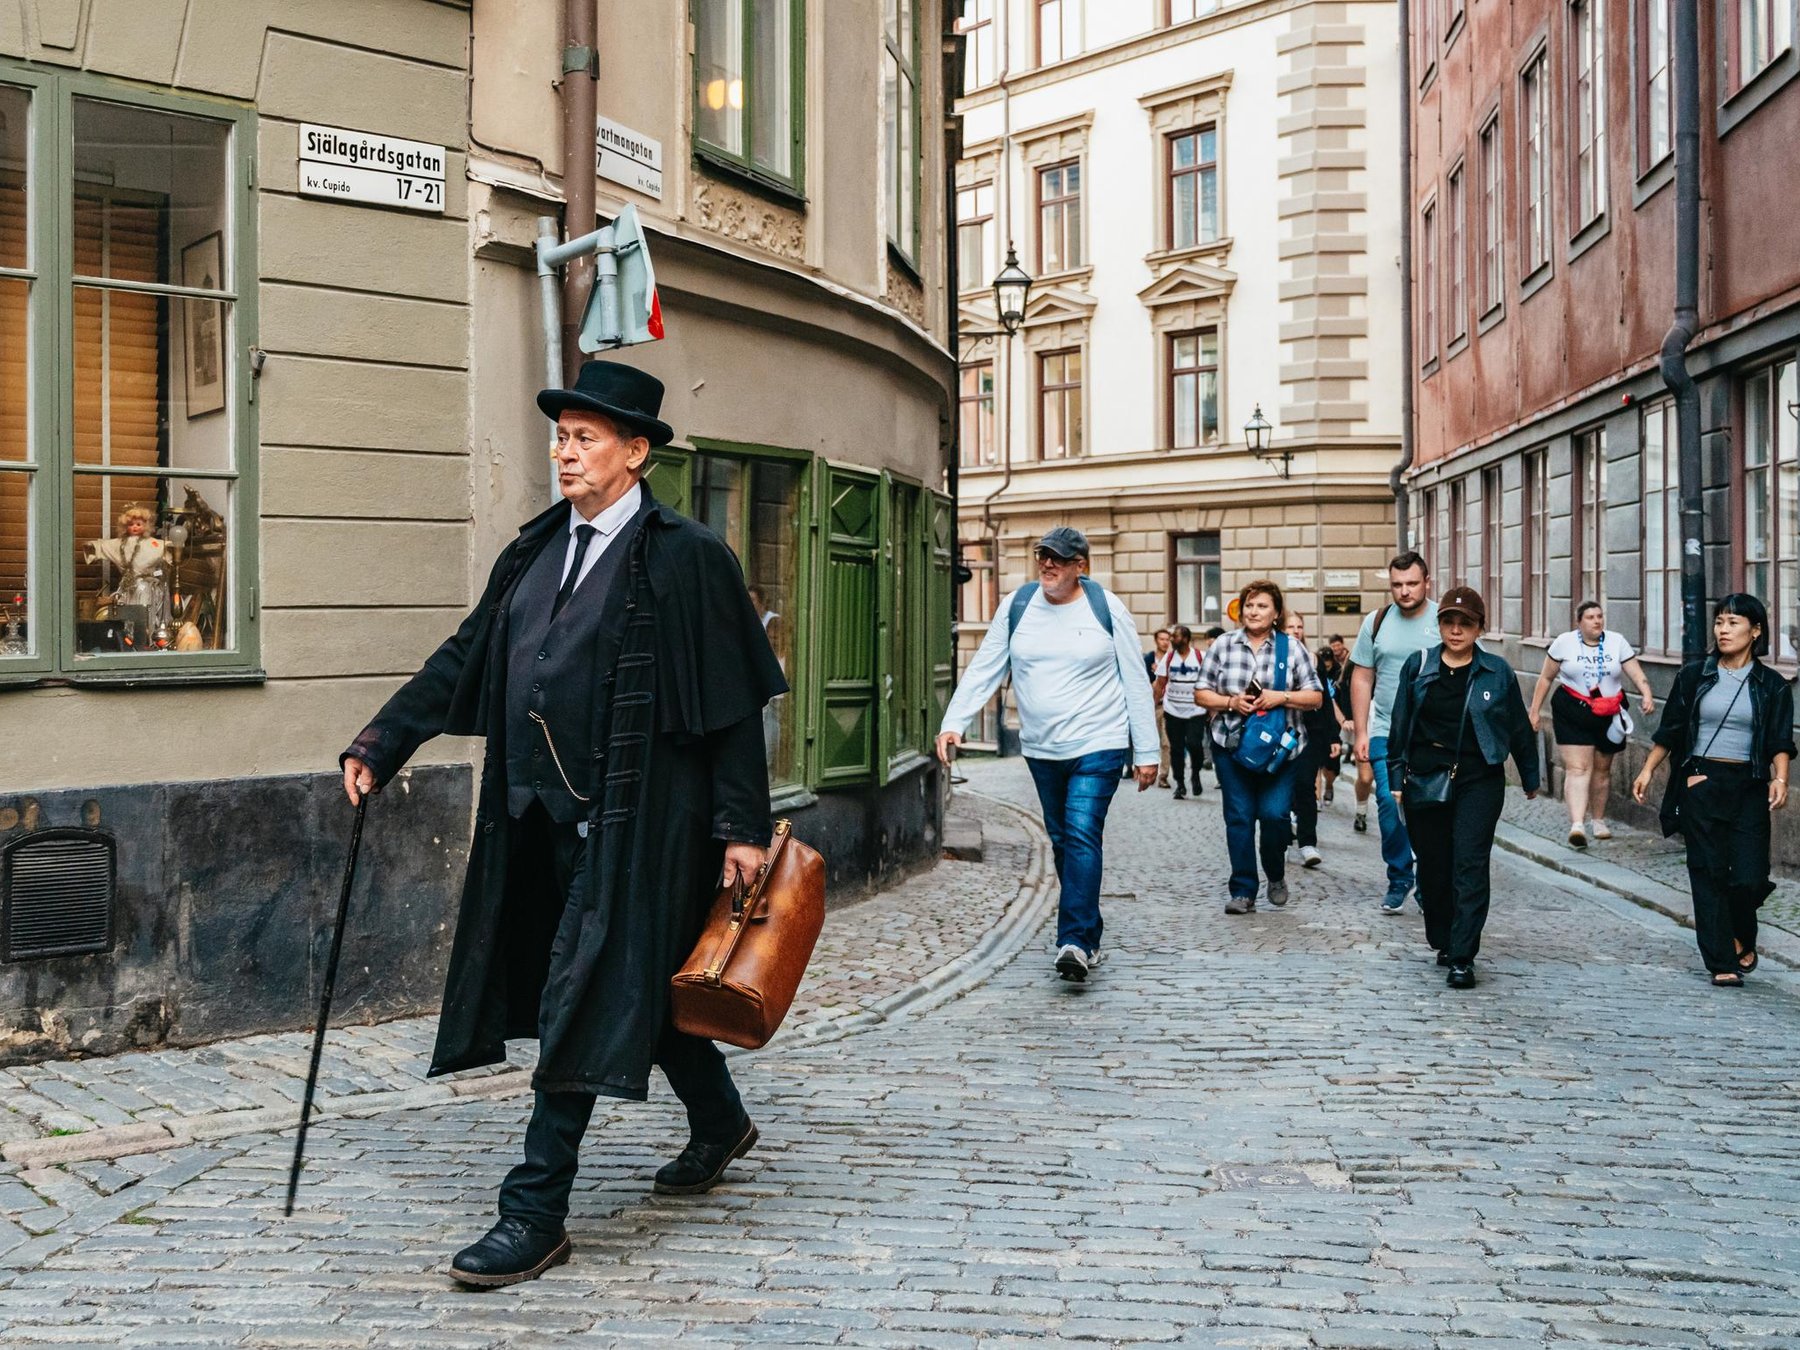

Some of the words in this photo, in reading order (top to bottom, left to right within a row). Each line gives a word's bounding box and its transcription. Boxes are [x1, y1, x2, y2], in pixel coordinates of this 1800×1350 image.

[307, 131, 441, 172] Själagårdsgatan
[596, 126, 653, 161] vartmangatan
[307, 176, 321, 189] kv.
[322, 179, 351, 193] Cupido
[397, 178, 441, 204] 17-21
[646, 180, 661, 193] Cupido
